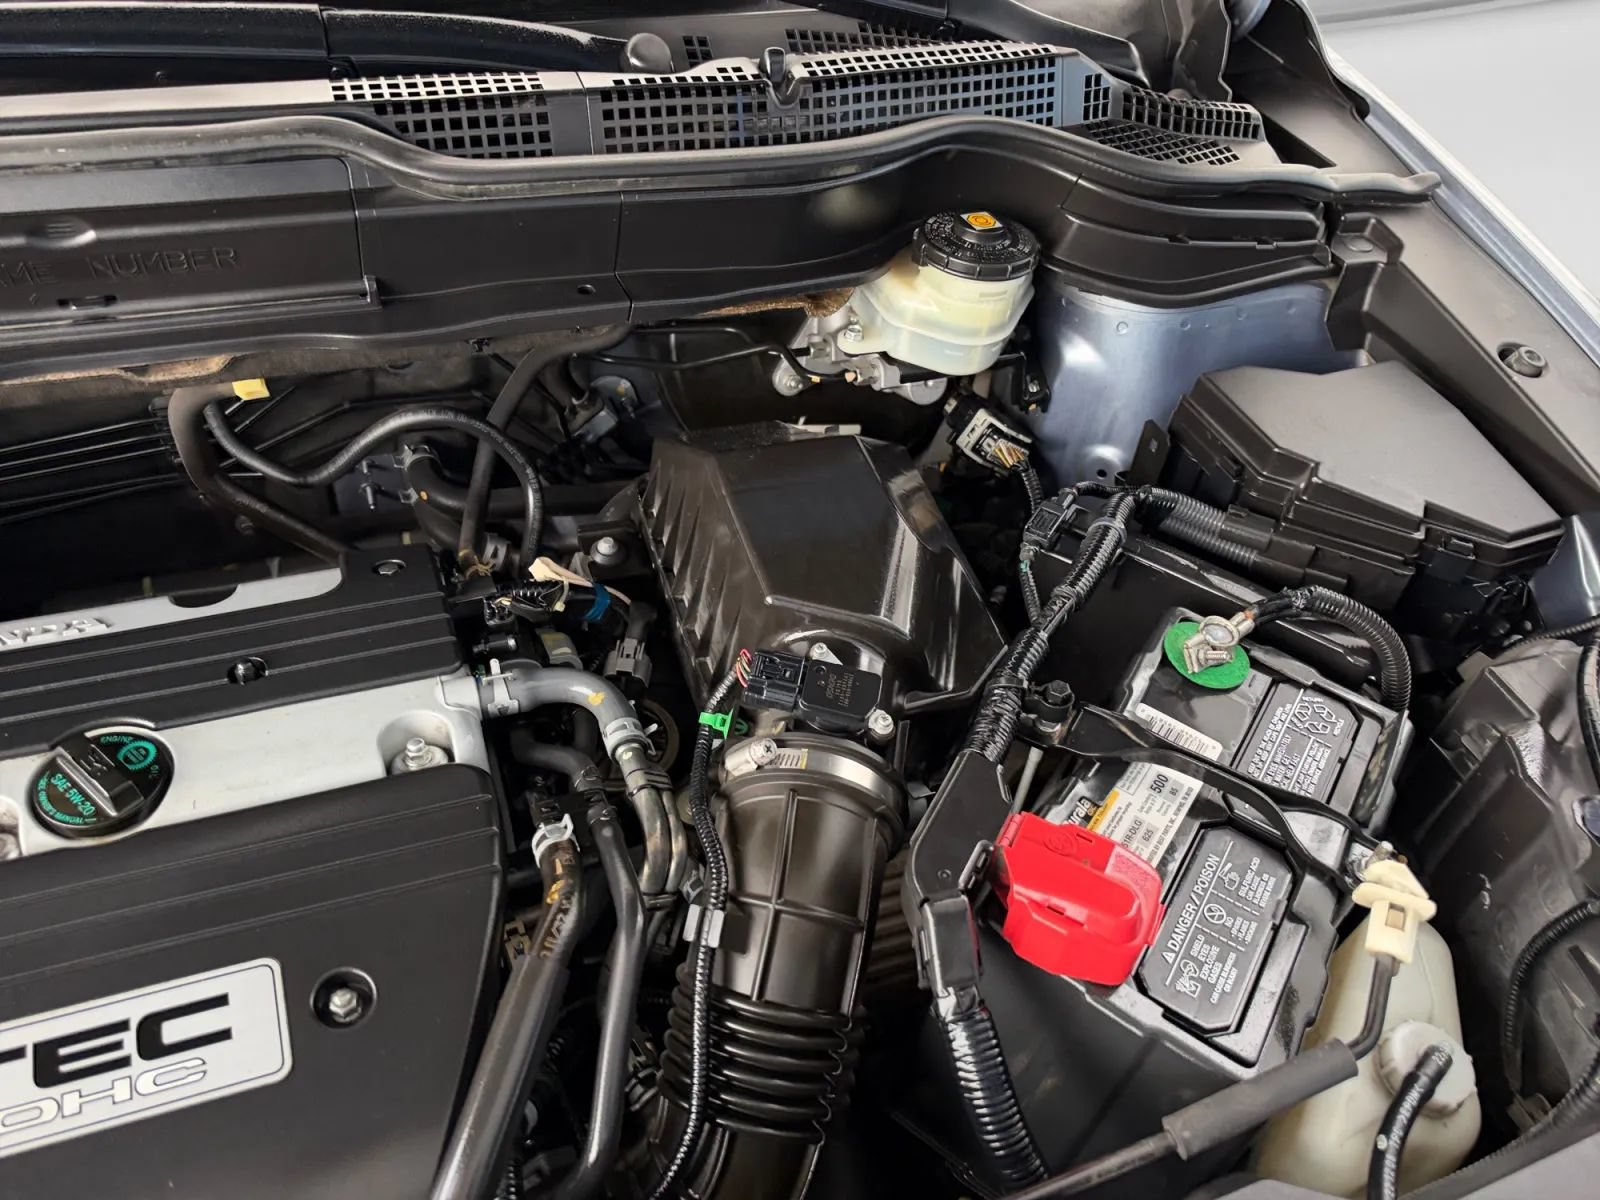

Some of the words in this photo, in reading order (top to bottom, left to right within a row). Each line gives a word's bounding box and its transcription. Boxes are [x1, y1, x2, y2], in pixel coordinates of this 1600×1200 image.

[86, 247, 238, 281] NUMBER
[100, 735, 134, 746] ENGINE
[1290, 753, 1300, 766] FAST
[50, 773, 73, 793] SAE
[65, 787, 97, 816] 5W-20
[1150, 773, 1169, 794] 500
[1169, 787, 1178, 796] 85
[54, 811, 85, 825] MANUAL
[1142, 829, 1153, 842] 625
[1238, 870, 1255, 897] SULFURIC
[1249, 856, 1261, 871] ACID
[1167, 902, 1197, 951] DANGER
[1192, 853, 1220, 895] POISON
[1224, 916, 1234, 927] NO
[1190, 934, 1205, 957] SHIELD
[1198, 944, 1211, 961] EYES
[1199, 945, 1220, 980] EXPLOSIVE
[1207, 961, 1223, 984] GASES
[0, 993, 233, 1088] EC
